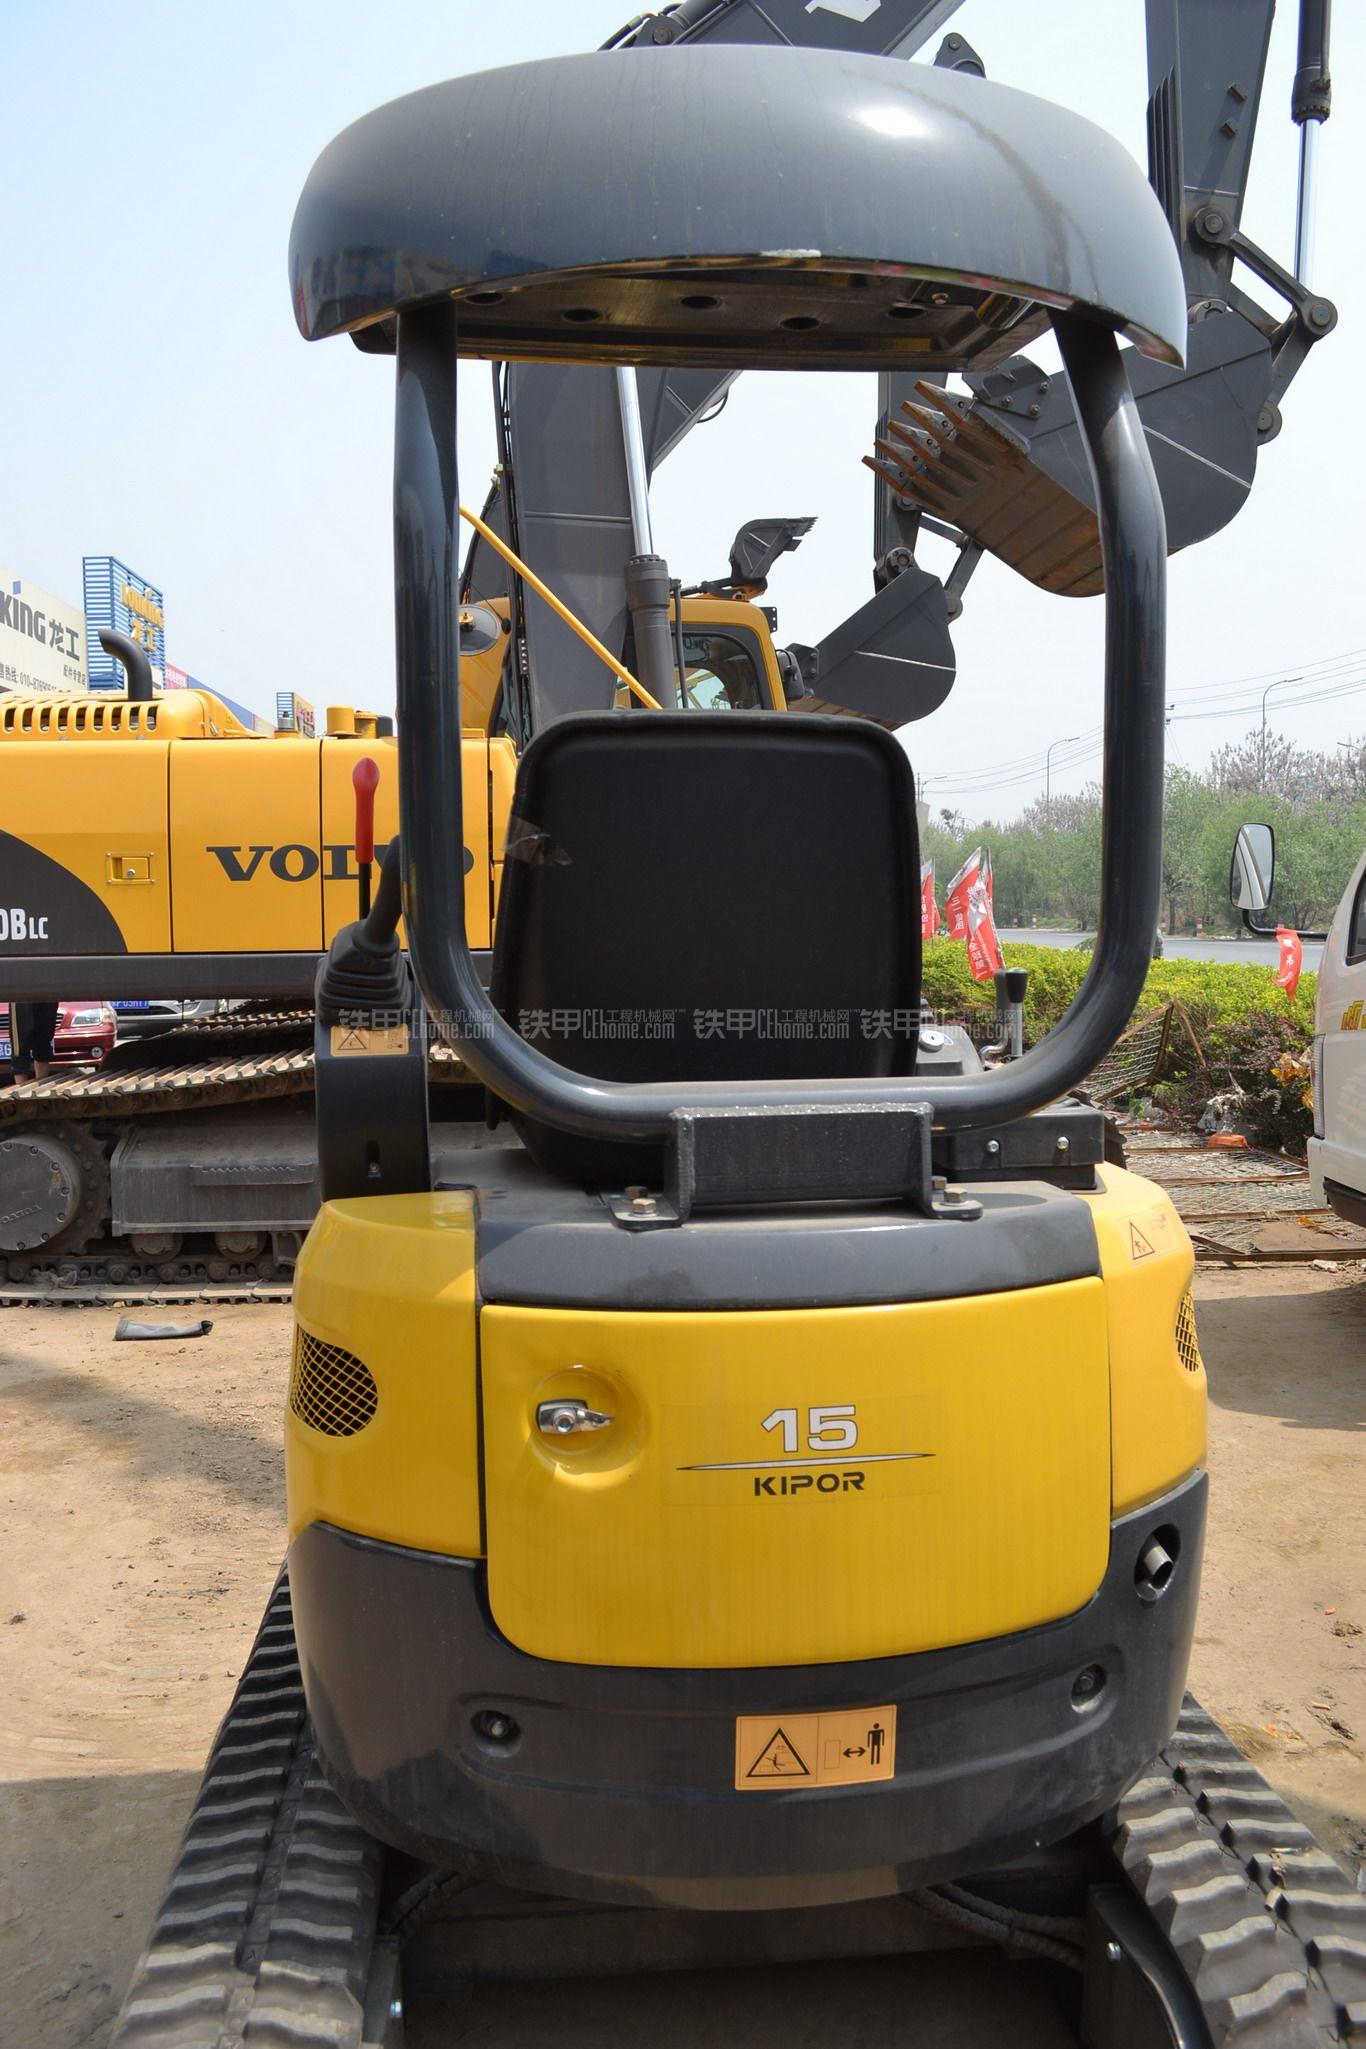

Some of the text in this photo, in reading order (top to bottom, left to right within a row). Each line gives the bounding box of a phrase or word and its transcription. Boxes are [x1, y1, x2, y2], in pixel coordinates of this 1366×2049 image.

[206, 844, 475, 882] VOL
[760, 1404, 859, 1454] 15
[754, 1471, 866, 1497] KIPOR
